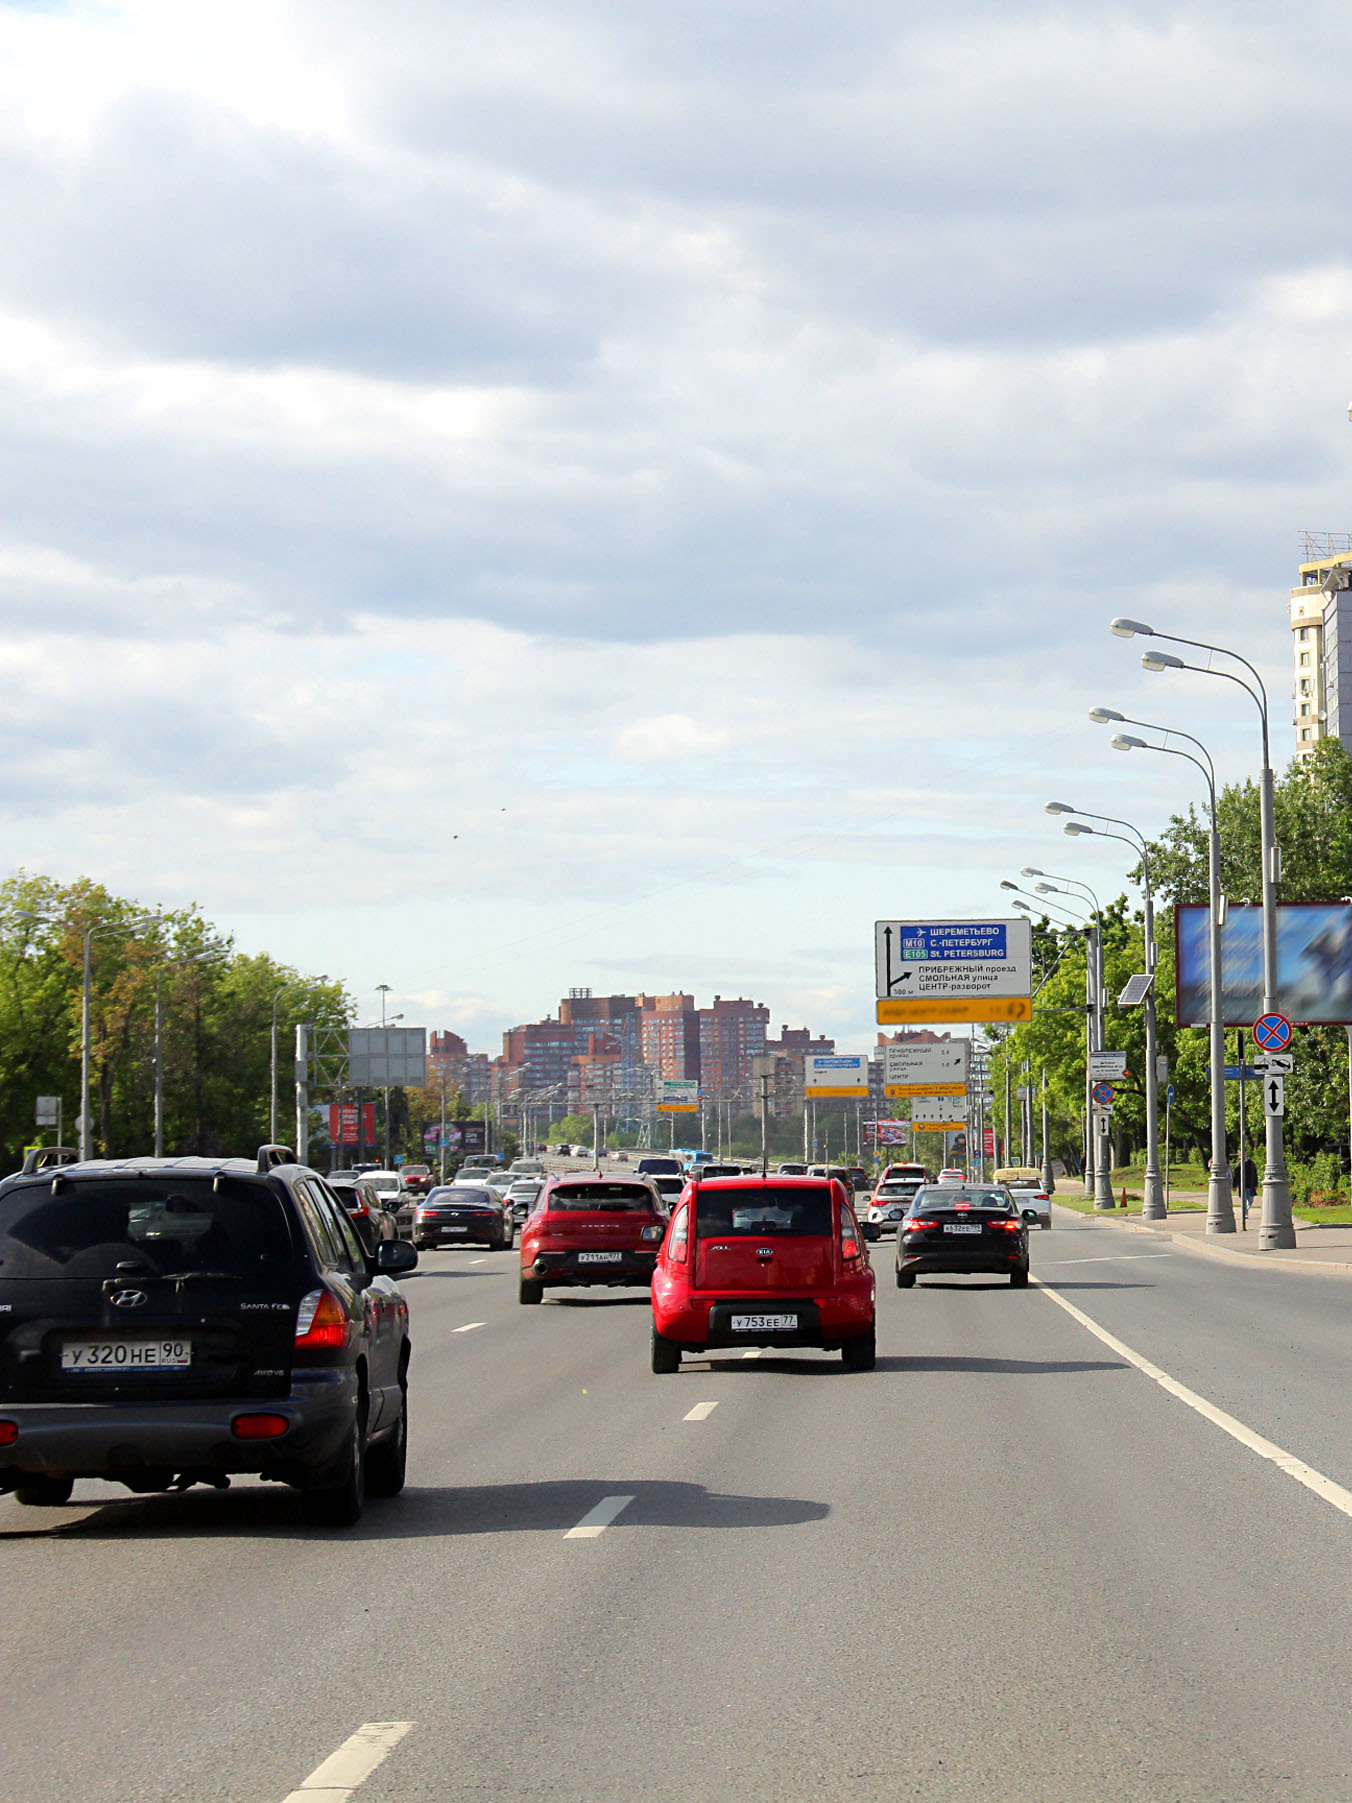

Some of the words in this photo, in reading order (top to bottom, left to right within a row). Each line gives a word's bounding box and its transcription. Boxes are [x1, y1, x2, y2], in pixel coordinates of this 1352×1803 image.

[930, 927, 1000, 936] ШЕРЕМЕТЬЕВО
[930, 950, 942, 958] St.
[943, 949, 1004, 958] PETERSBURG
[918, 964, 983, 974] ПРИБРЕЖНЫЙ
[918, 974, 971, 982] СМОЛЬНАЯ
[918, 983, 991, 991] ЦЕНТР-разворот
[162, 1343, 184, 1358] 90
